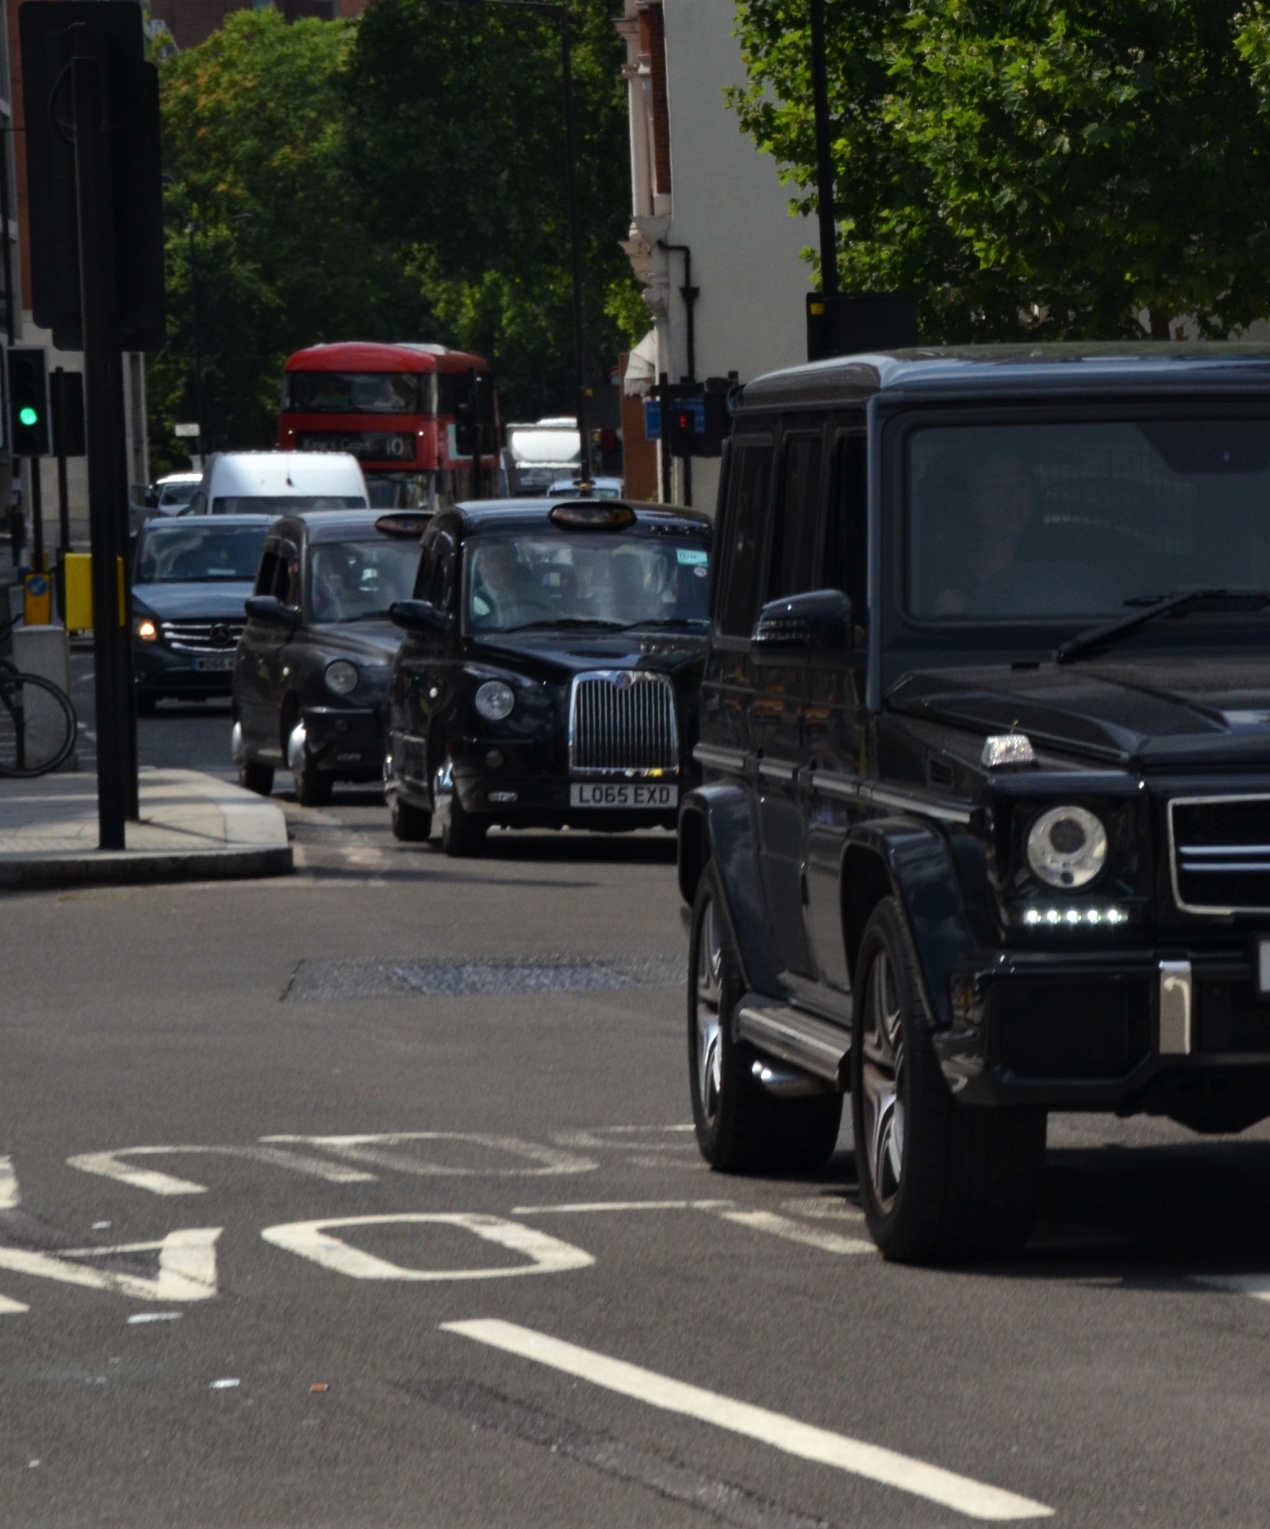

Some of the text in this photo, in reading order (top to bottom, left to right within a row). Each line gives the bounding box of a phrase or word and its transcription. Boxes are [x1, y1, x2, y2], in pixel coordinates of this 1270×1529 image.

[386, 437, 404, 456] 10
[579, 785, 670, 804] LO65 EXD
